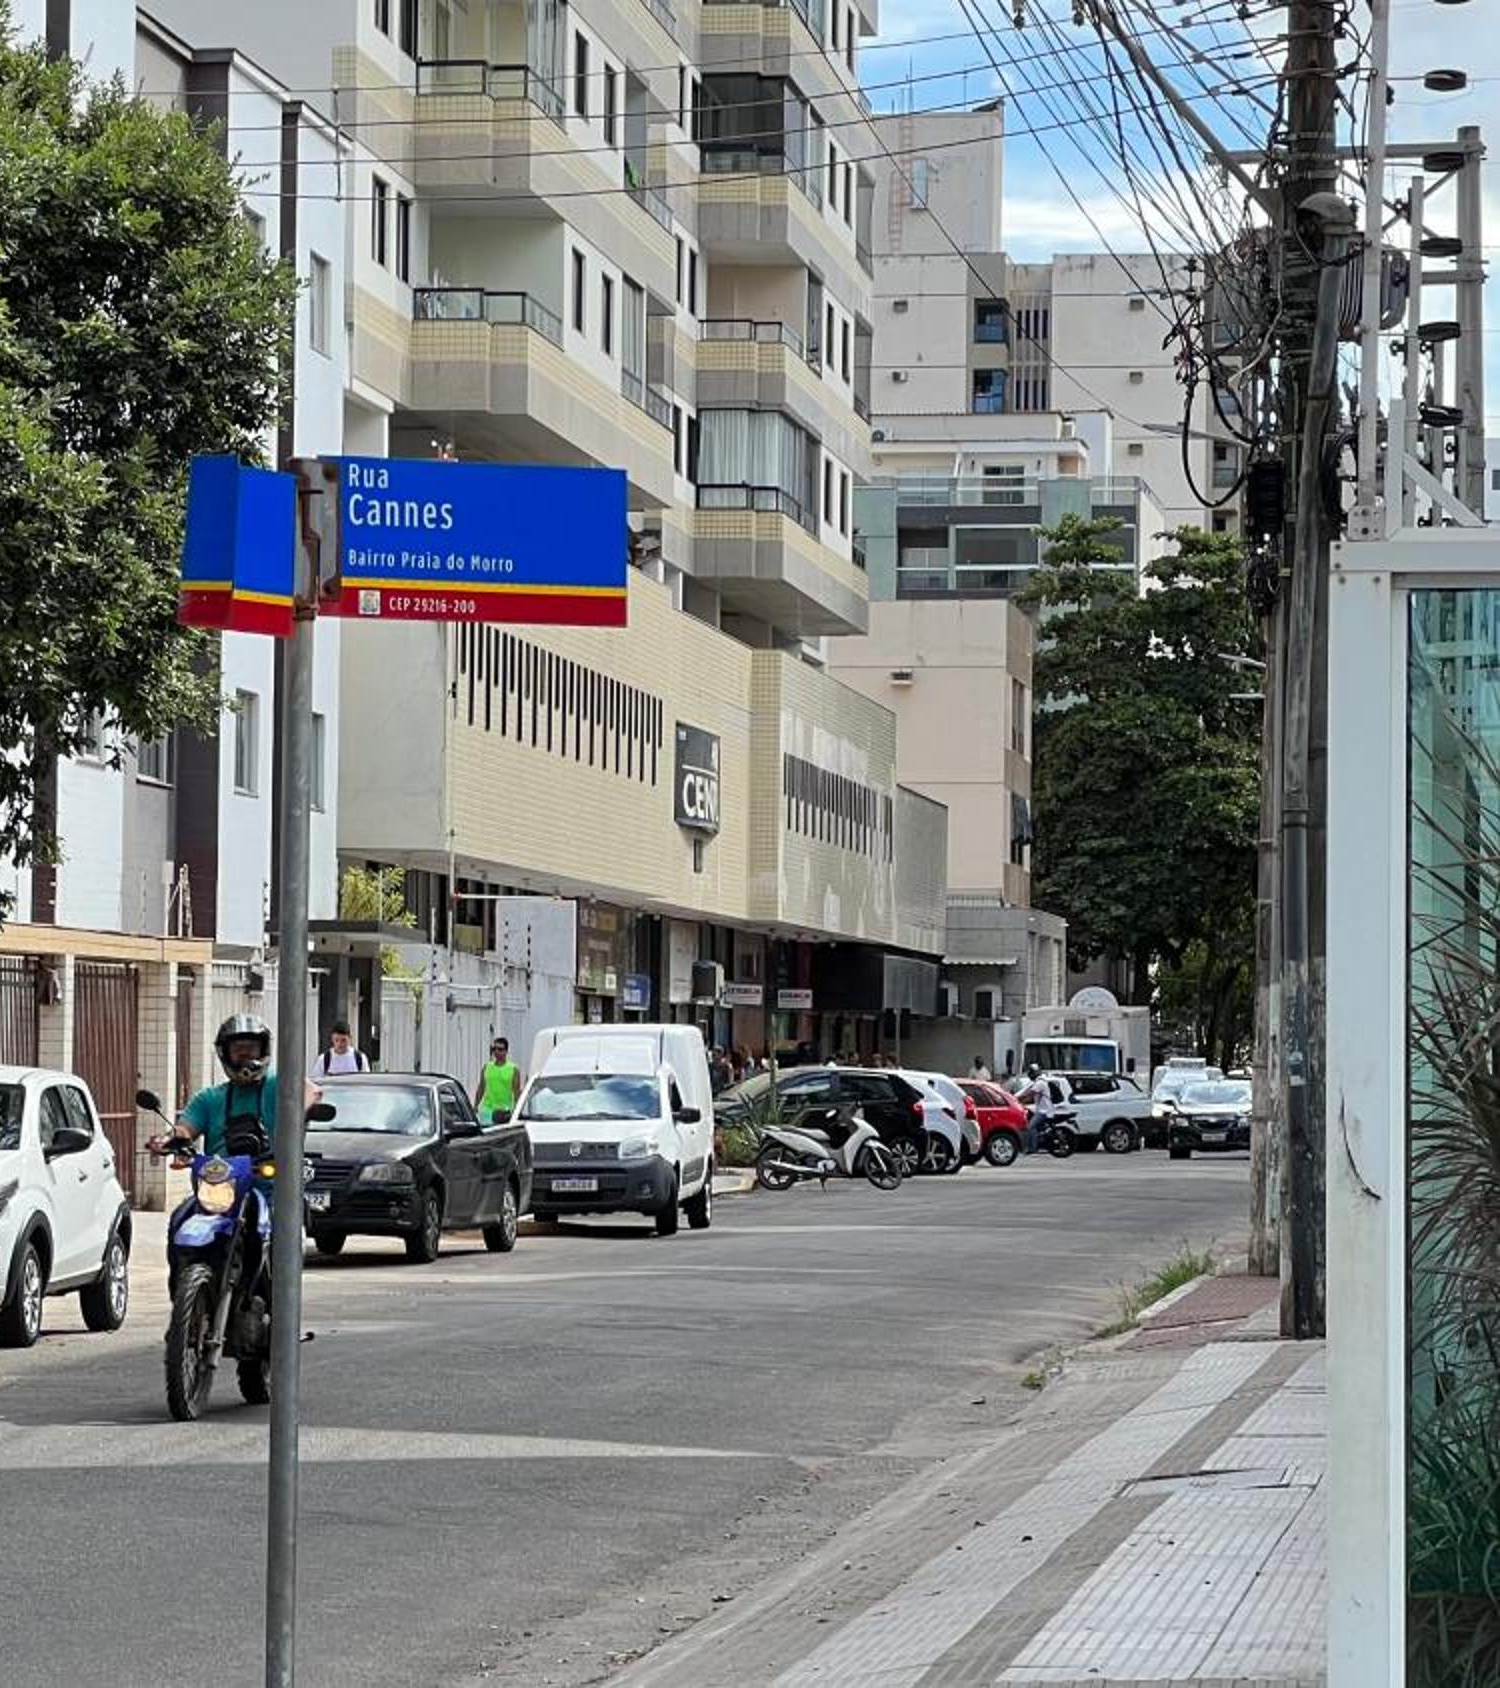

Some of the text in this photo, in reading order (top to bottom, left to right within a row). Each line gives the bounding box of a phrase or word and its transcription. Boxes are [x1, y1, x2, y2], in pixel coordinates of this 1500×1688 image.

[349, 463, 389, 489] Rua
[349, 493, 453, 530] Cannes
[348, 548, 514, 573] Bairro Praia do Morro
[389, 597, 477, 614] CEP 29216-200
